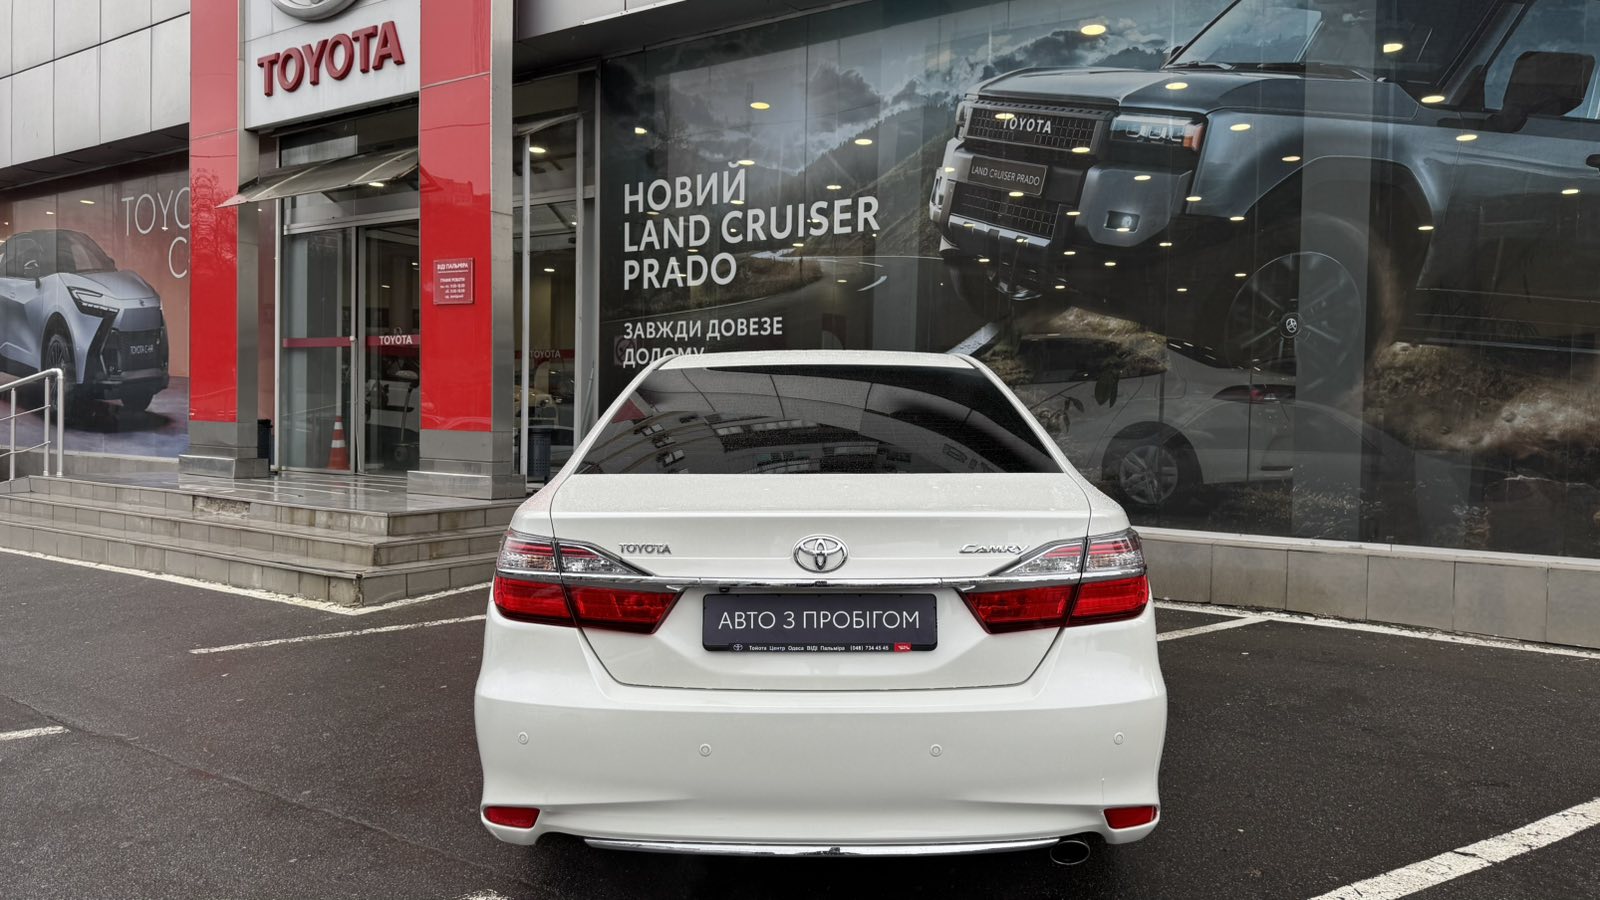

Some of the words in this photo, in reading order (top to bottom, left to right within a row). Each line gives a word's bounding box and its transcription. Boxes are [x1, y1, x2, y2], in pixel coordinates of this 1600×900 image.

[257, 21, 405, 97] TOYOTA
[1002, 117, 1051, 134] TOYOTA
[971, 165, 989, 178] LAND
[989, 168, 1015, 181] CRUISER
[1016, 173, 1040, 186] PRADO
[624, 161, 746, 214] НОВИЙ
[624, 214, 710, 252] LAND
[721, 196, 880, 244] CRUISER
[624, 252, 737, 290] PRADO
[379, 334, 413, 345] TOYOTA
[623, 320, 702, 342] ЗАВЖДИ
[706, 317, 783, 341] ДОВЕЗЕ
[530, 350, 560, 358] TOYOTA
[618, 544, 672, 555] TOYOTA
[718, 611, 776, 629] АВТО
[803, 610, 920, 629] ПРОБІГОМ
